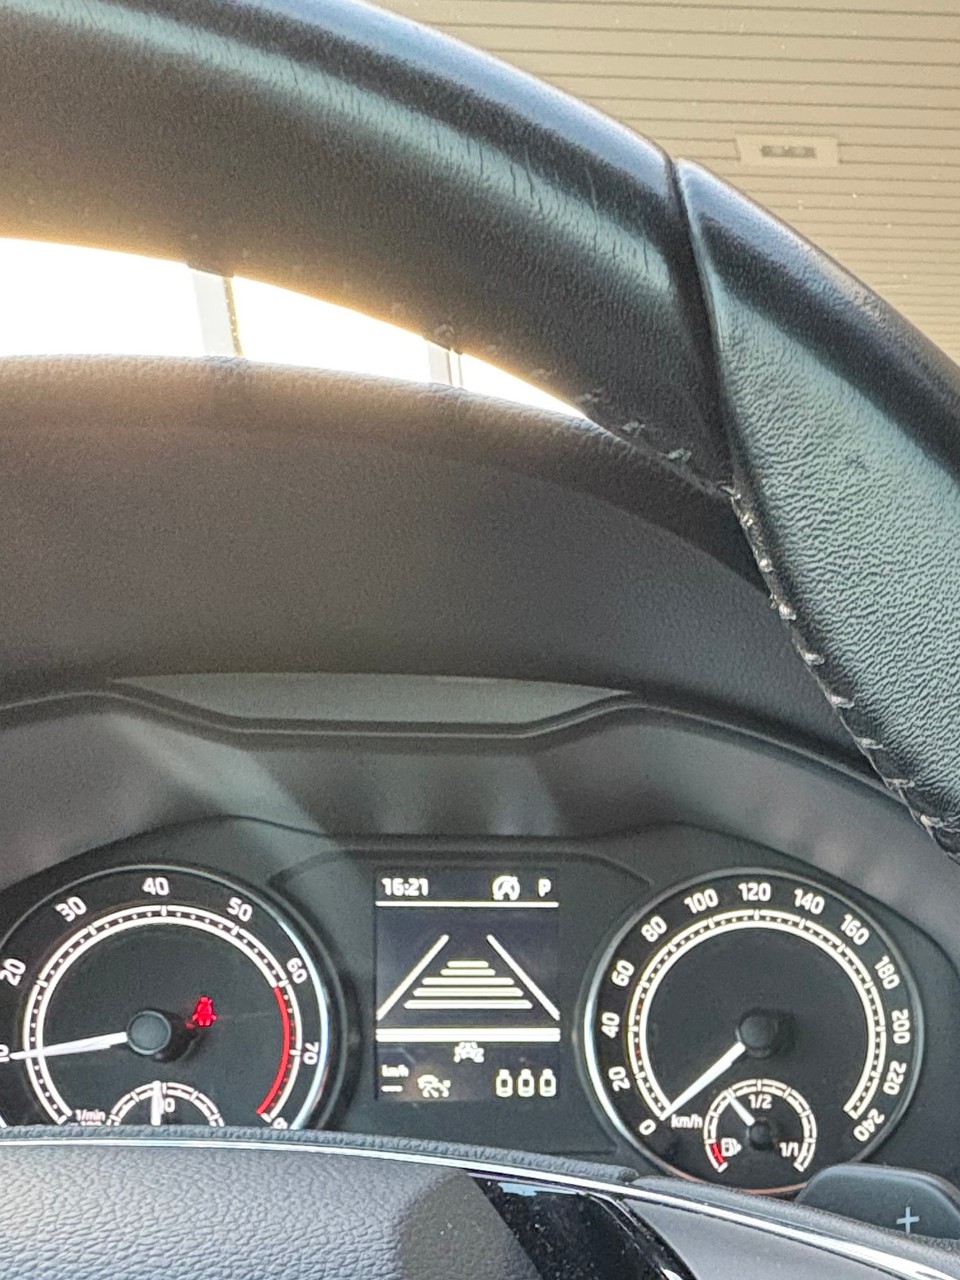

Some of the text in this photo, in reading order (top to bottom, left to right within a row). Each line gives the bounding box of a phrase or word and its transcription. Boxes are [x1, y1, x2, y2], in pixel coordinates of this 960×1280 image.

[142, 877, 170, 896] 40
[381, 878, 429, 896] 16:21
[538, 879, 551, 897] P
[738, 882, 771, 901] 120
[55, 896, 87, 922] 30
[227, 897, 253, 922] 50
[684, 888, 719, 914] 100
[793, 888, 825, 915] 140
[641, 916, 667, 943] 80
[839, 914, 869, 946] 160
[0, 958, 27, 986] 20
[286, 957, 308, 984] 60
[611, 960, 635, 987] 60
[874, 956, 900, 990] 180
[601, 1012, 620, 1038] 40
[891, 1009, 911, 1044] 200
[303, 1042, 319, 1065] 70
[608, 1066, 630, 1091] 20
[883, 1061, 906, 1095] 220
[749, 1094, 772, 1109] 1/2
[75, 1109, 105, 1121] 1/min
[639, 1119, 656, 1136] 0
[671, 1114, 703, 1128] km/h
[852, 1108, 885, 1142] 240
[779, 1142, 798, 1157] 1/1
